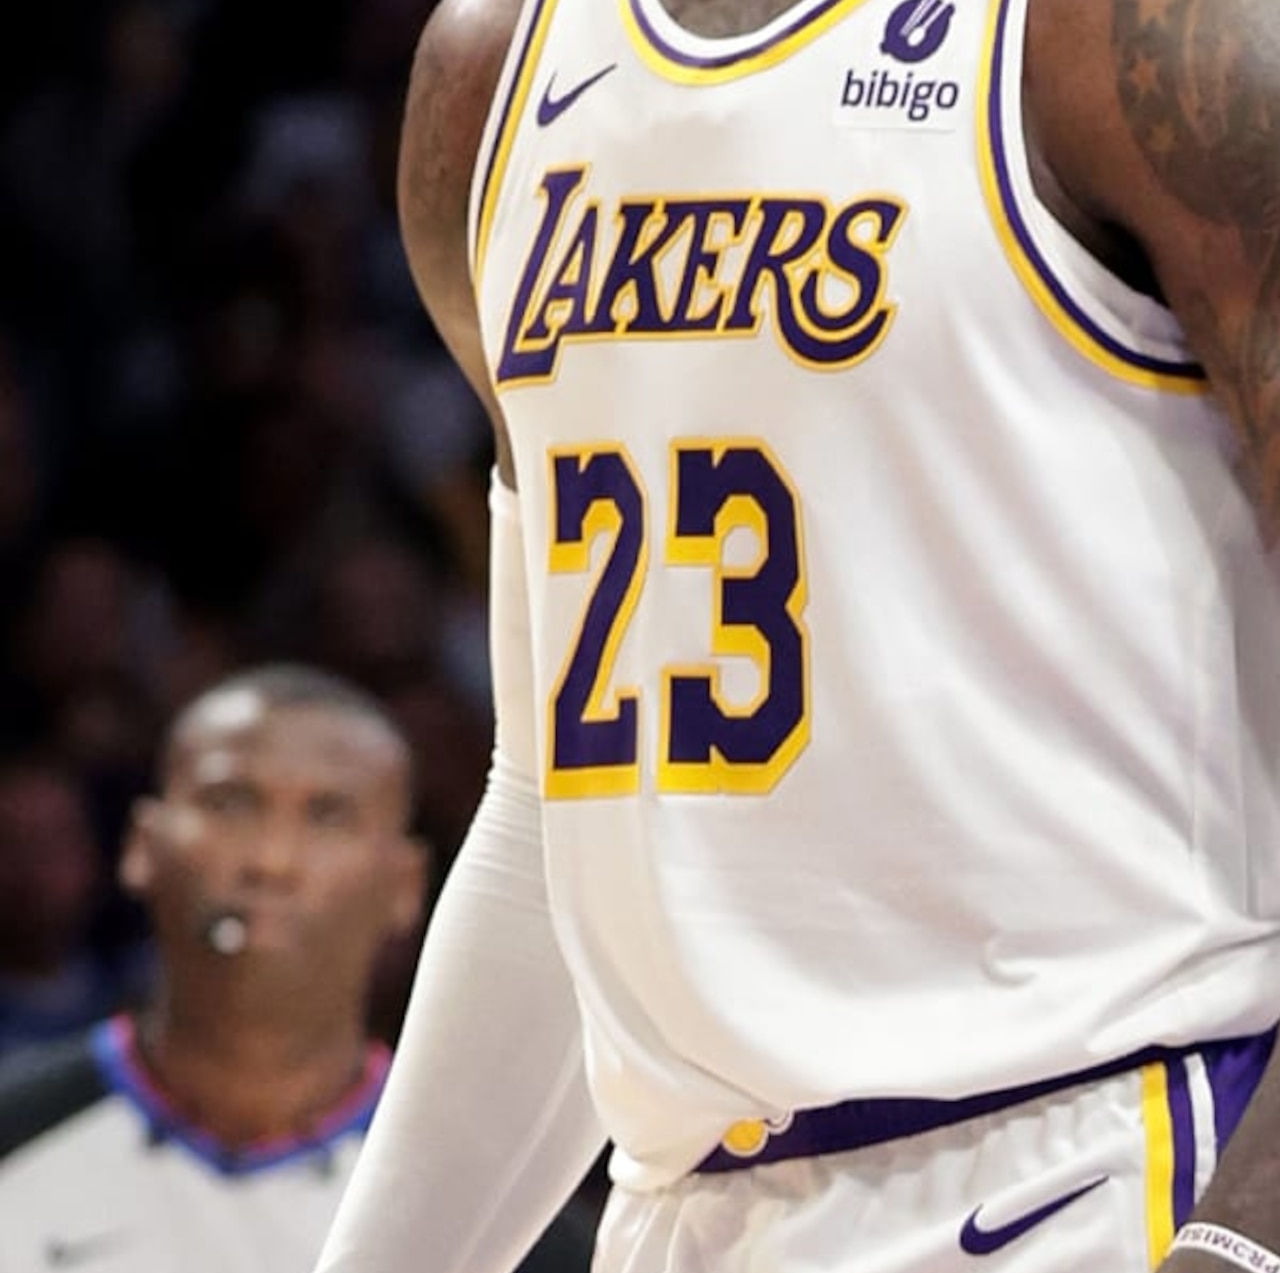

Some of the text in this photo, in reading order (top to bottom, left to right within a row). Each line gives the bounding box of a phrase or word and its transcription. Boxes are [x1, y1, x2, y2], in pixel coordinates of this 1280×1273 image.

[840, 69, 959, 121] bibigo
[497, 161, 909, 390] LAKERS
[544, 436, 811, 801] 23
